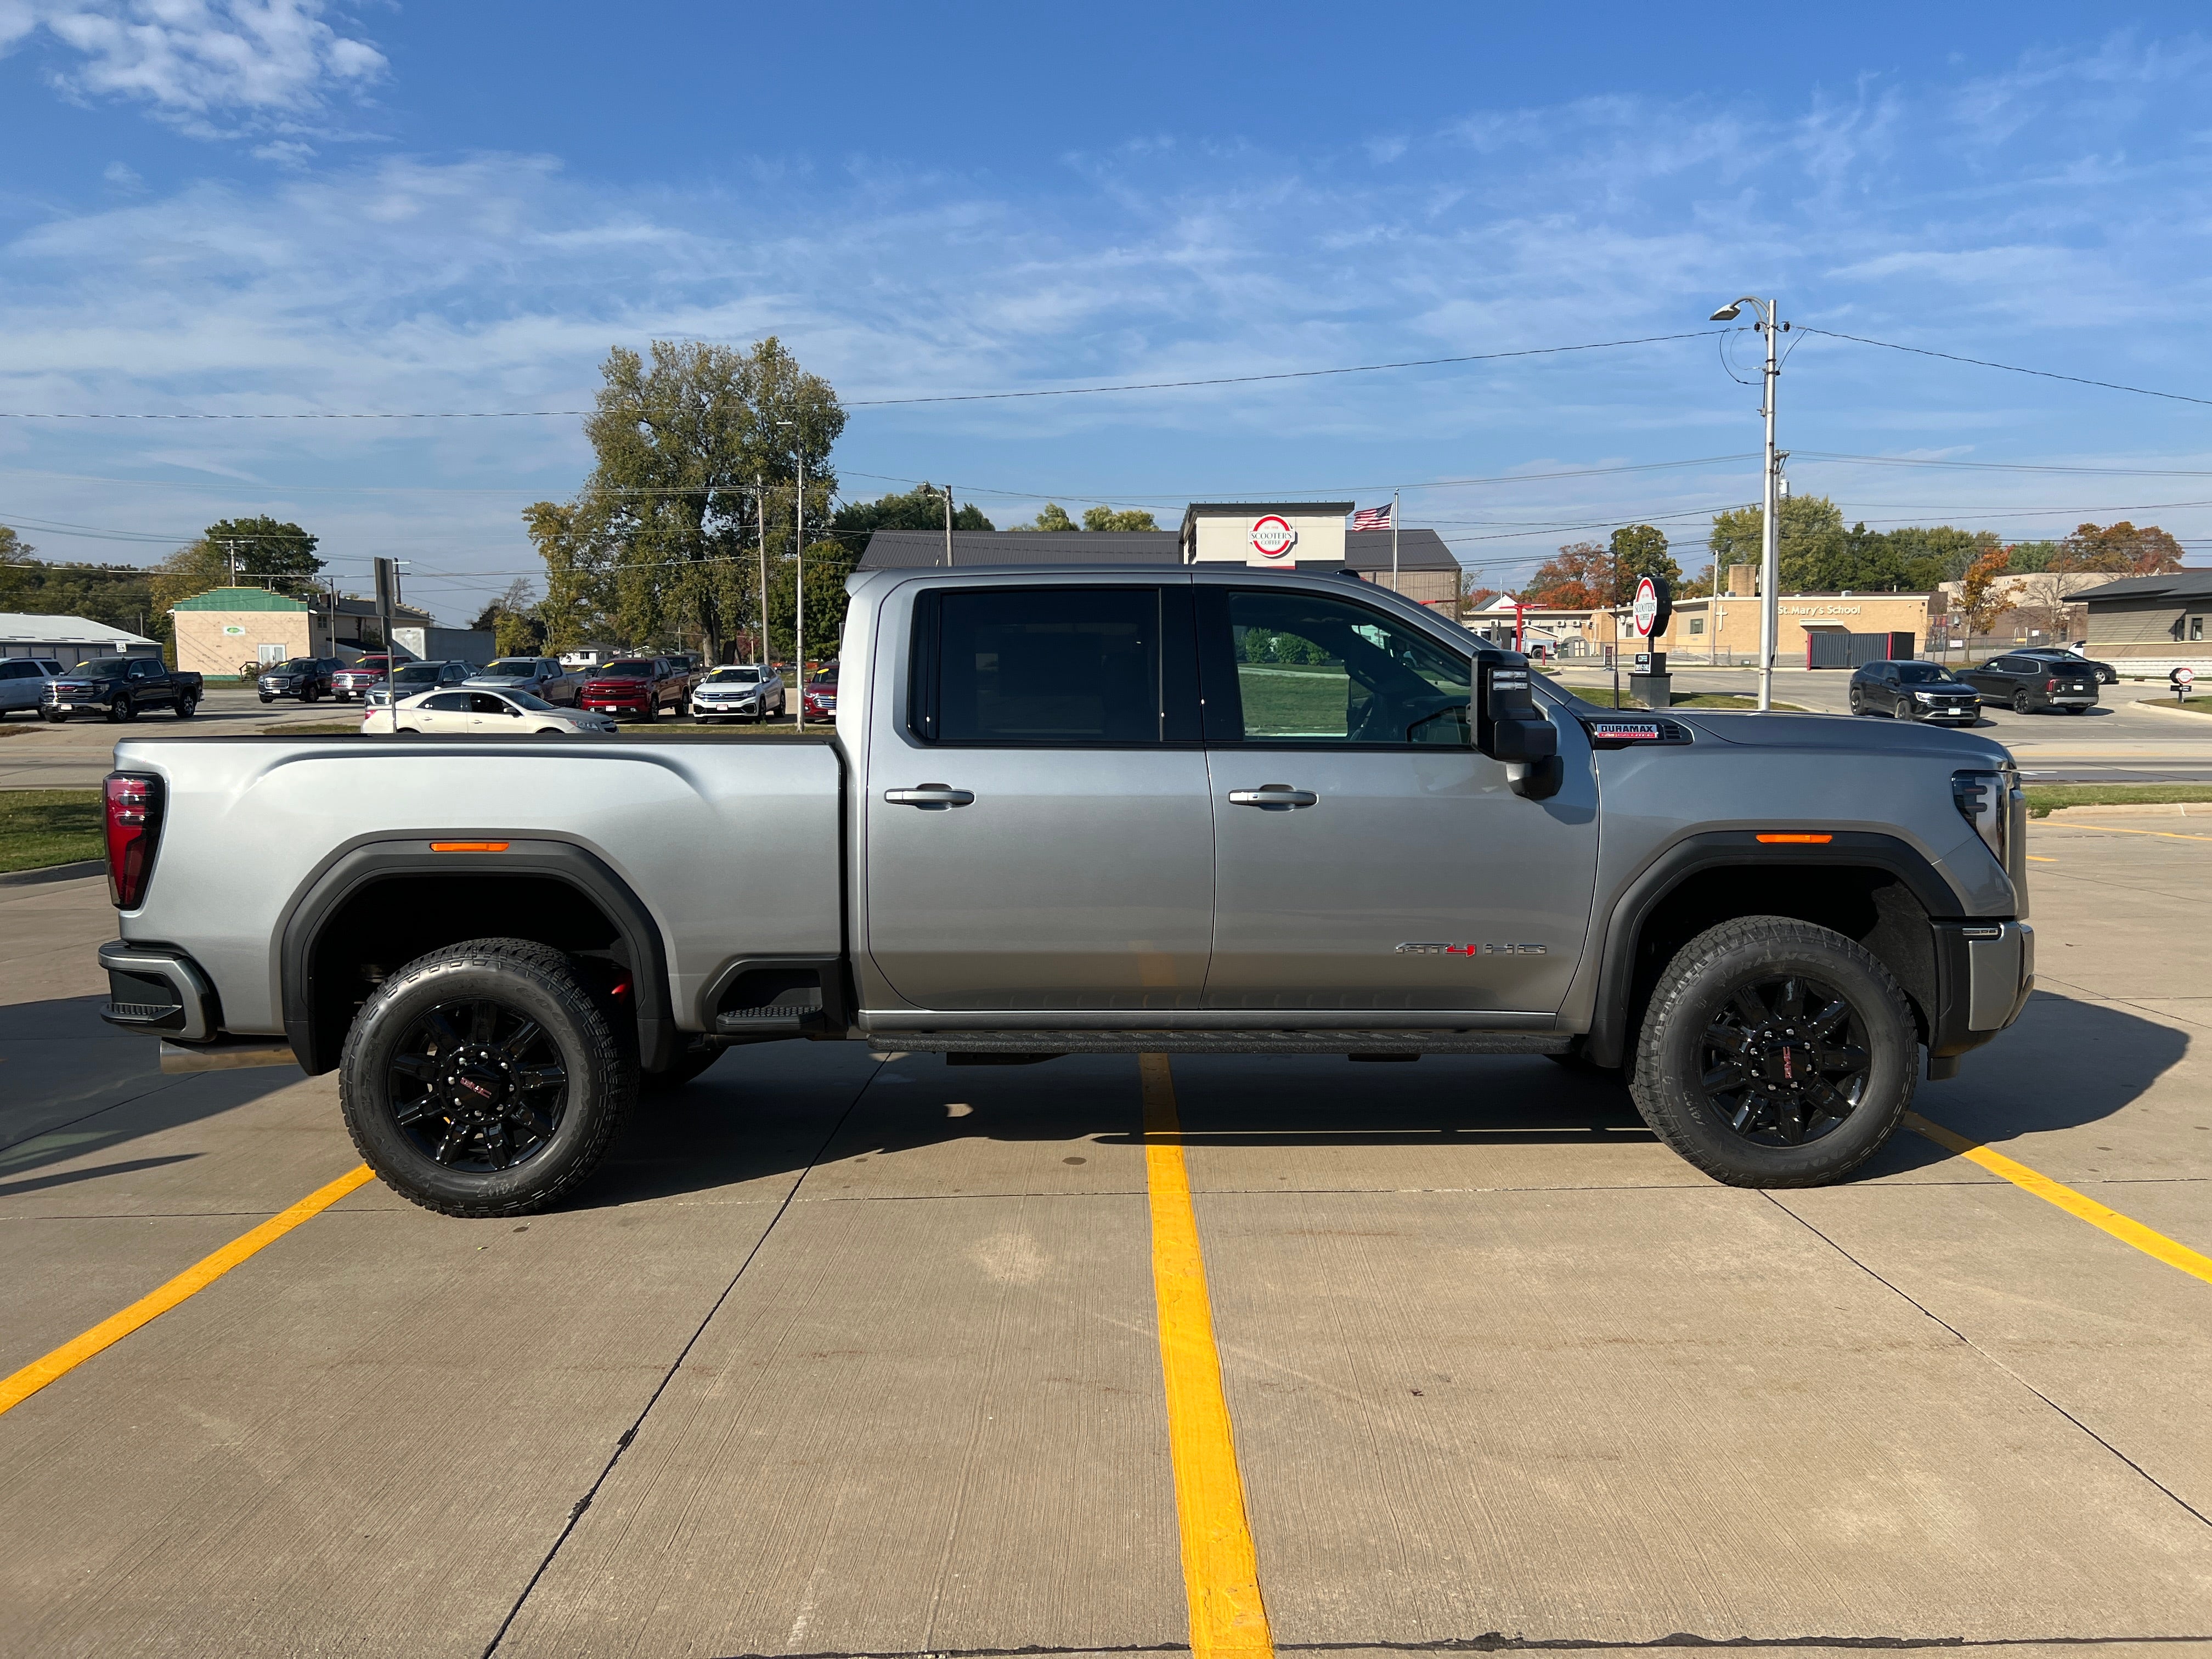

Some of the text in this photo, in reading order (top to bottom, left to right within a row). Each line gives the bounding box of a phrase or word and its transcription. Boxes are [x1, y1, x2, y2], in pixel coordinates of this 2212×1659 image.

[1827, 605, 1861, 615] School
[1395, 941, 1547, 958] AT4 HD
[1782, 1046, 1792, 1080] GMC
[460, 1076, 492, 1099] GMC
